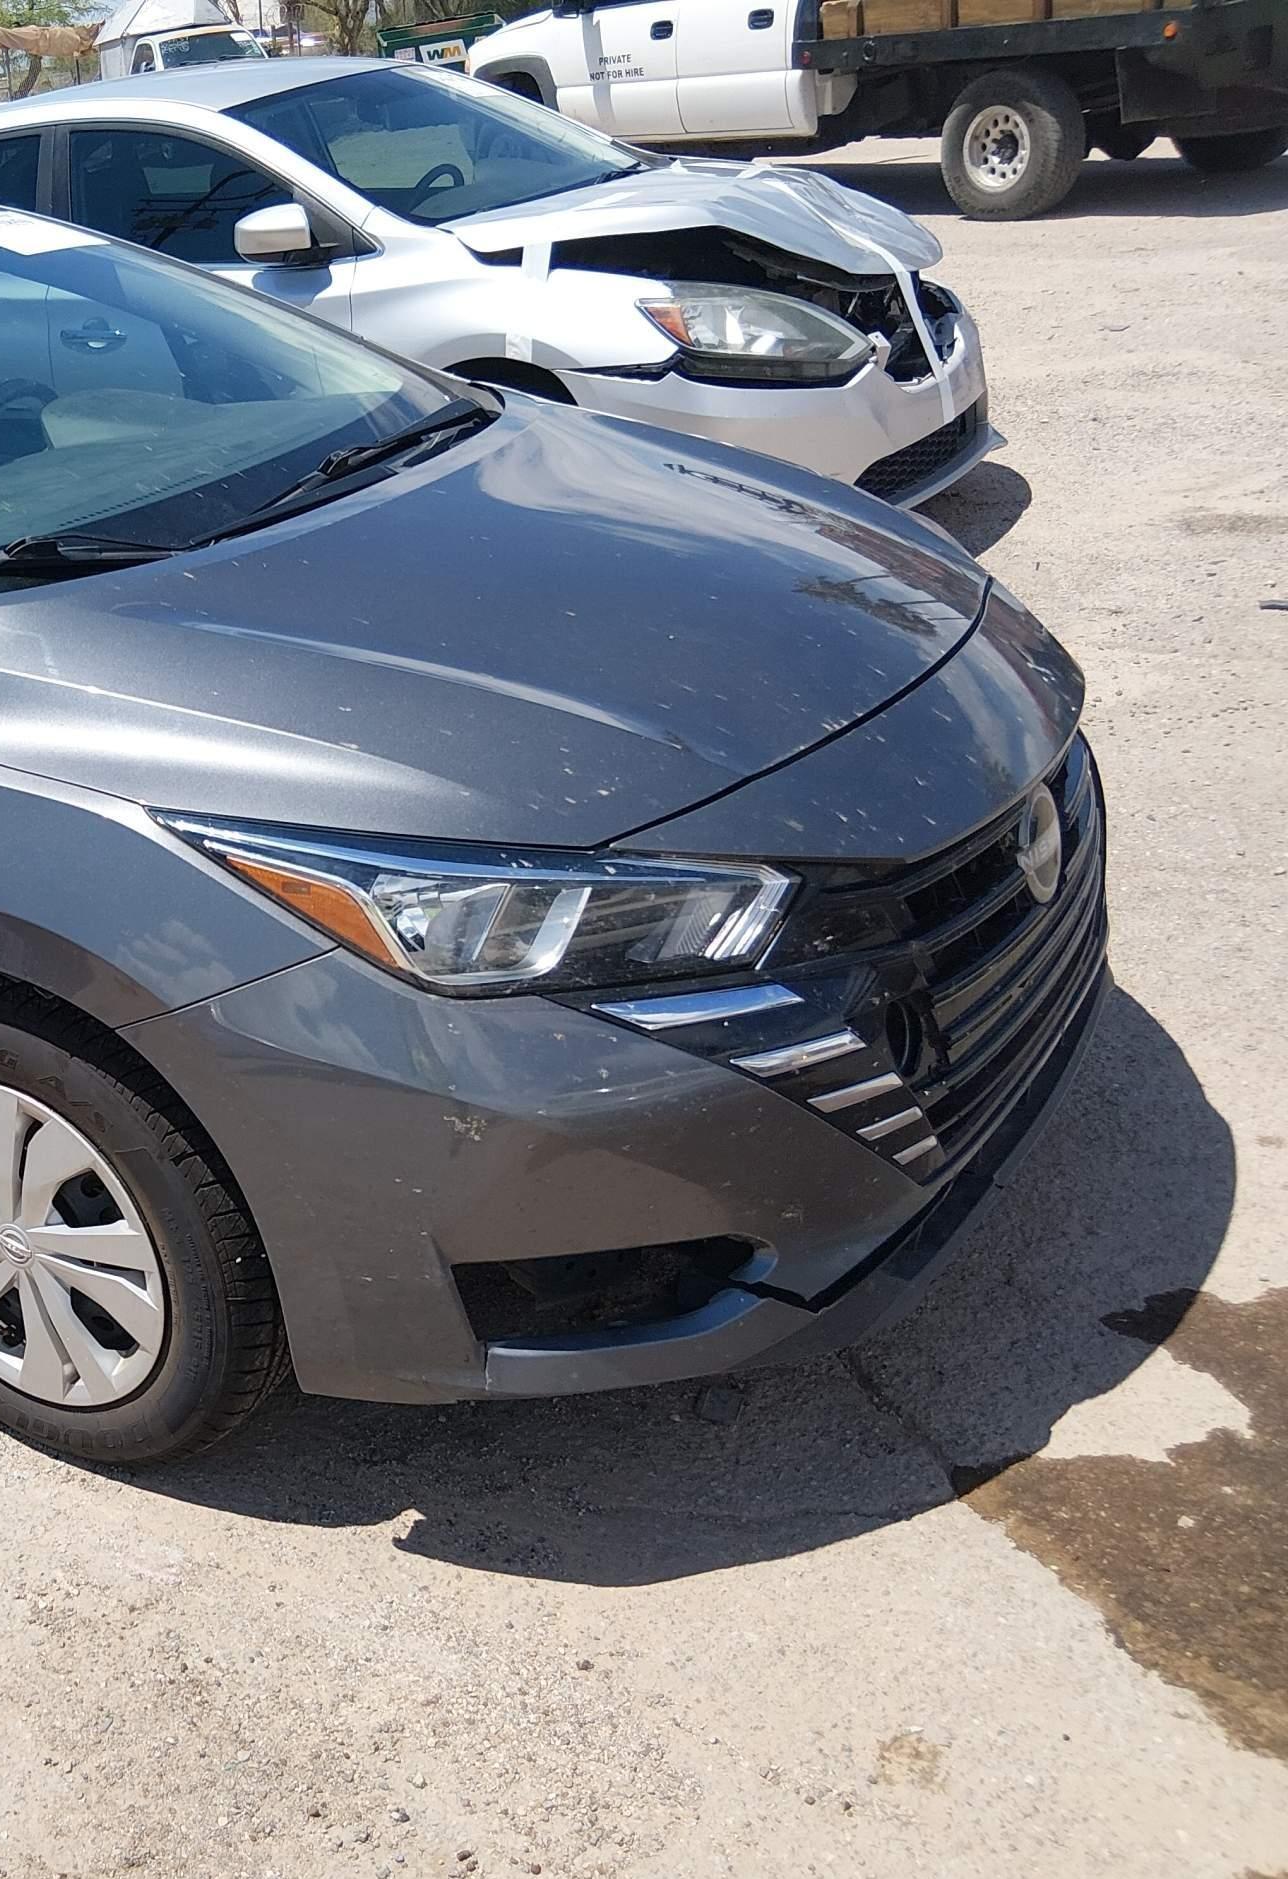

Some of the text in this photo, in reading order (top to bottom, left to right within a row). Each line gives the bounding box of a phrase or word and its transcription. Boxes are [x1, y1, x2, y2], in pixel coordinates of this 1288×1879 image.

[426, 45, 462, 61] WM
[598, 53, 632, 66] PRIVATE
[589, 67, 645, 81] NOT FOR HIRE
